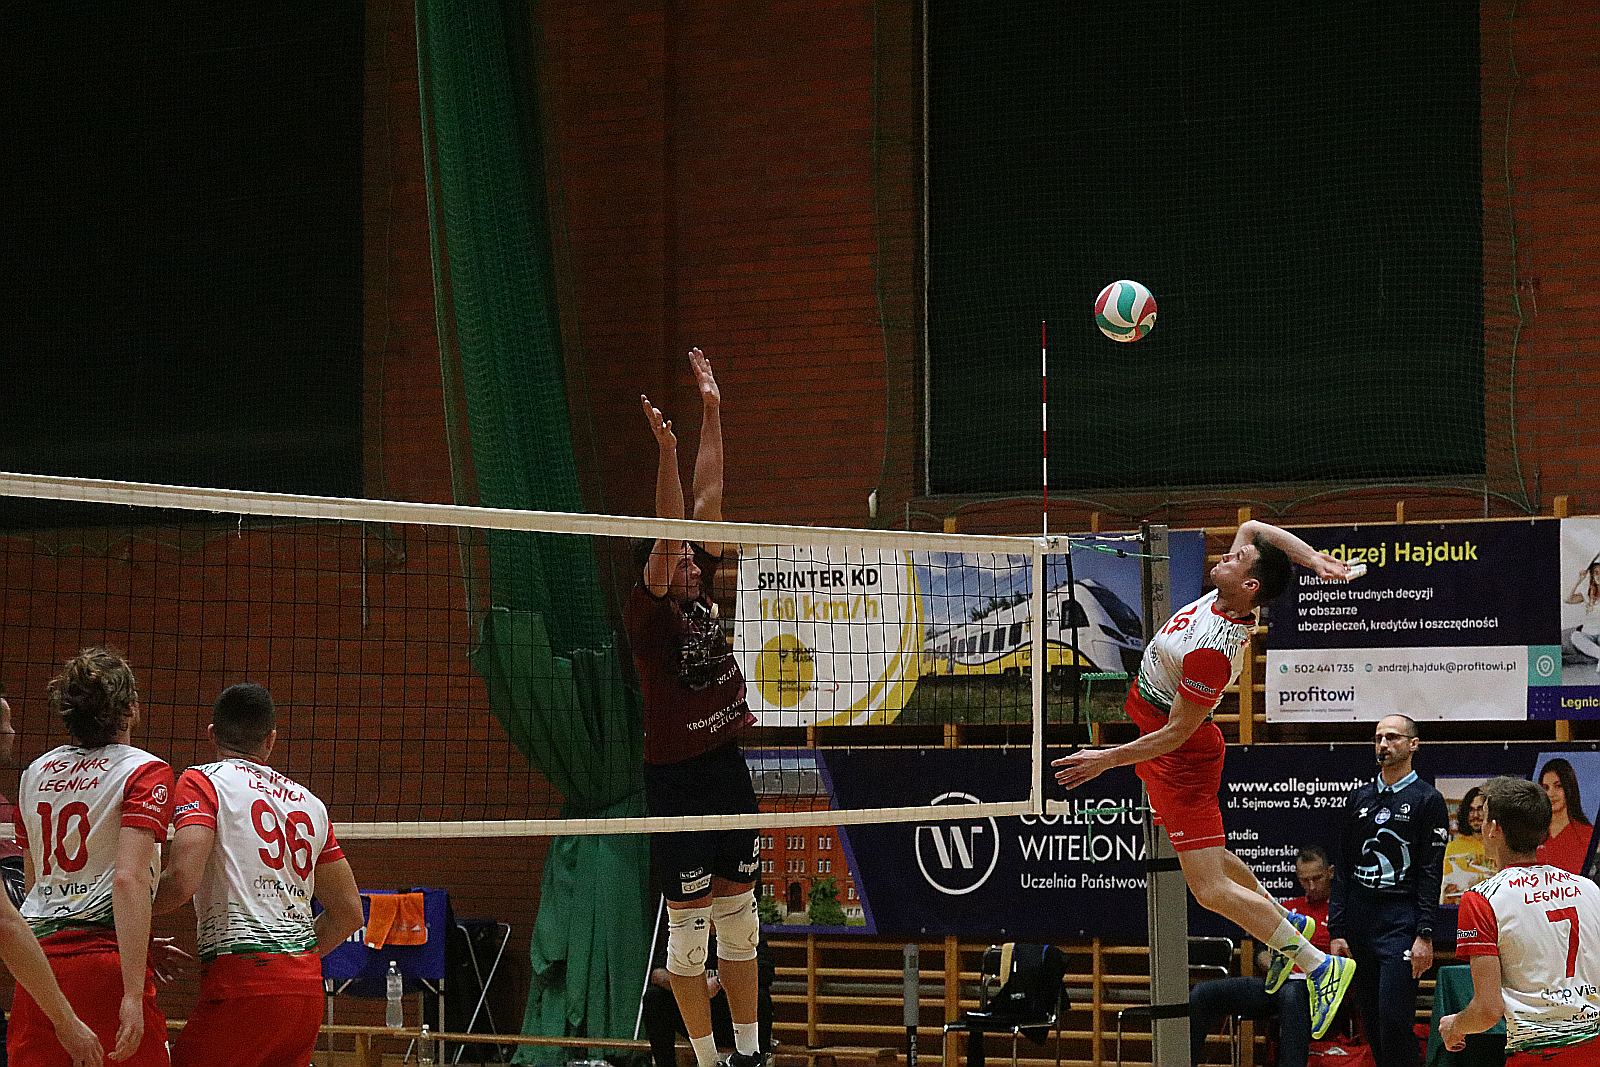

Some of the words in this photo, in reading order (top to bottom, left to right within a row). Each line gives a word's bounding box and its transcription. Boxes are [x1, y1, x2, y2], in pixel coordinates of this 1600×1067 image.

[1318, 543, 1386, 567] ndrzej
[1395, 541, 1479, 566] Hajduk
[758, 570, 846, 589] SPRINTER
[851, 568, 878, 587] KD
[1298, 589, 1347, 603] podjęcie
[1348, 588, 1394, 601] trudnych
[1395, 587, 1434, 600] decyzji
[760, 597, 796, 621] 160
[803, 594, 878, 621] km/h
[1298, 607, 1308, 616] w
[1309, 605, 1358, 616] obszarze
[1297, 619, 1369, 633] ubezpieczeń,
[1370, 618, 1418, 632] kredytów
[1425, 617, 1499, 631] oszczędności
[1294, 664, 1315, 673] 502
[1316, 664, 1335, 673] 441
[1337, 663, 1355, 673] 735
[1377, 661, 1517, 674] andrzej.hajduk@profitowi.pl
[1279, 686, 1355, 705] profitowi
[1561, 696, 1600, 710] Legnic
[70, 758, 109, 774] IKAR
[38, 777, 100, 793] LEGNICA
[1228, 777, 1375, 796] www.collegiumwit
[1227, 797, 1240, 809] ul.
[1242, 797, 1290, 811] Sejmowa
[1293, 797, 1311, 809] 5A,
[37, 801, 91, 876] 10
[251, 799, 315, 881] 96
[1228, 829, 1259, 841] studia
[1235, 845, 1300, 859] magisterskie
[1020, 873, 1076, 889] Uczelnia
[1508, 873, 1539, 888] MKS
[1545, 871, 1580, 885] IKAR
[59, 883, 87, 896] Vita
[1524, 886, 1581, 904] LEGNICA
[1545, 906, 1580, 978] 7
